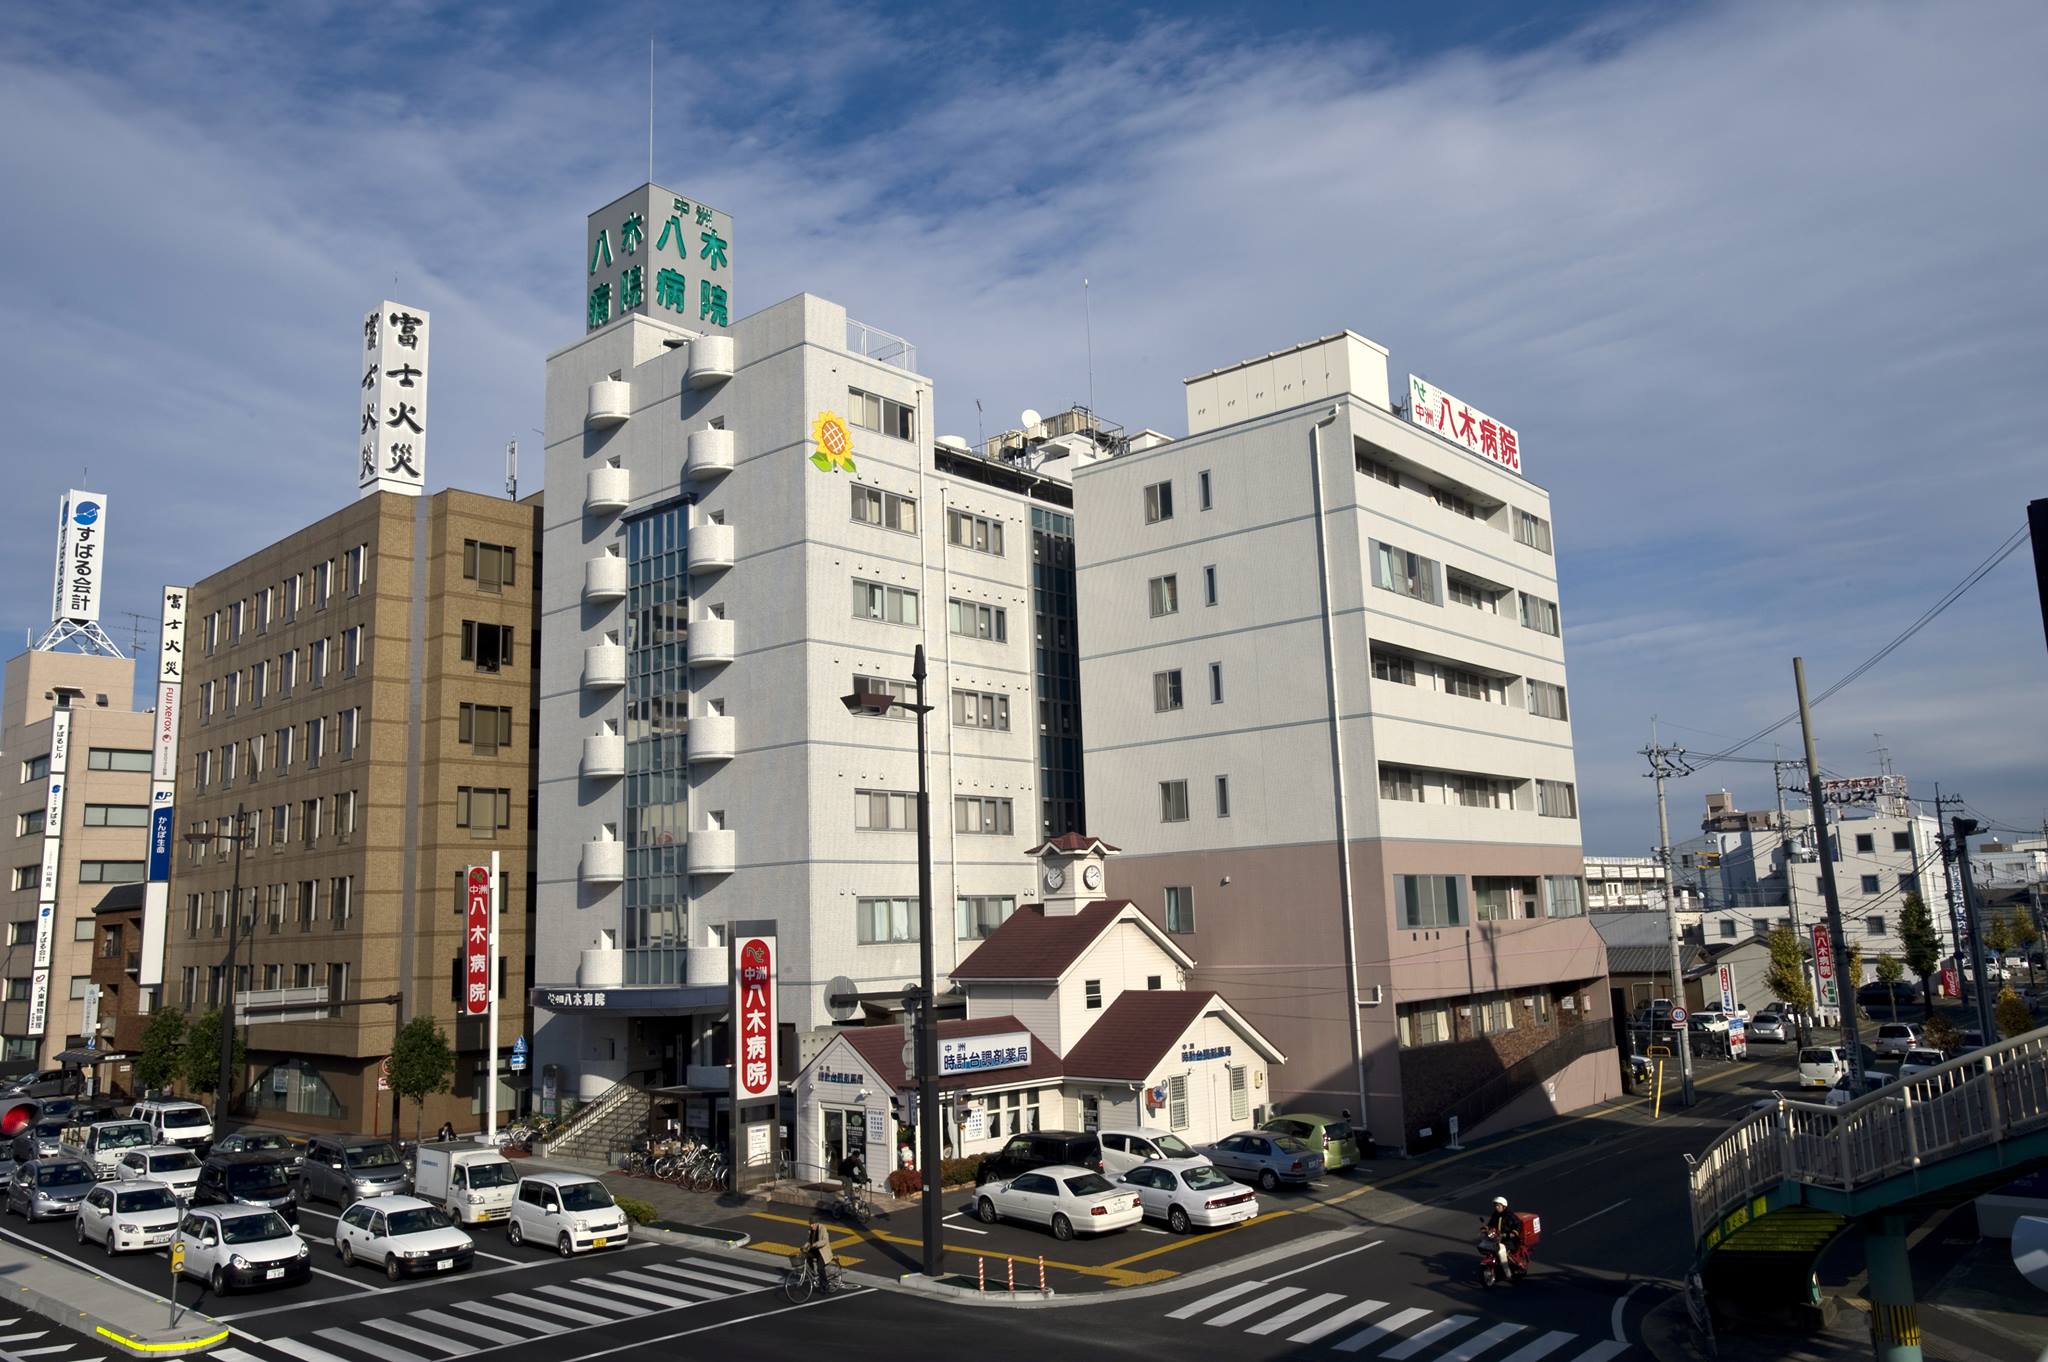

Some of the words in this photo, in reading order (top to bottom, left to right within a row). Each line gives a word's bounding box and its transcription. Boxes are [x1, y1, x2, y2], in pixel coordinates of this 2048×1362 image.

[674, 197, 713, 229] 中洲
[591, 211, 645, 275] 八木
[656, 215, 728, 271] 八木
[589, 265, 644, 329] 病院
[656, 268, 728, 328] 病院
[360, 312, 380, 480] 富士火災
[385, 312, 424, 478] 富士火災
[1415, 403, 1434, 428] 中洲
[1438, 397, 1518, 469] 八木病院
[71, 527, 96, 611] すばる会計
[164, 593, 183, 676] 富士火災
[166, 687, 174, 704] FUJI
[55, 724, 65, 759] すばるビル
[156, 816, 168, 854] かんぽ生命
[469, 885, 488, 895] 中洲
[470, 896, 486, 1003] 八木病院
[1817, 937, 1831, 976] 八木病院
[744, 966, 767, 981] 中洲
[746, 984, 768, 1088] 八木病院
[1674, 1010, 1684, 1019] 40
[944, 1046, 1028, 1070] 時計台調剤薬局
[945, 1043, 966, 1052] 中洲
